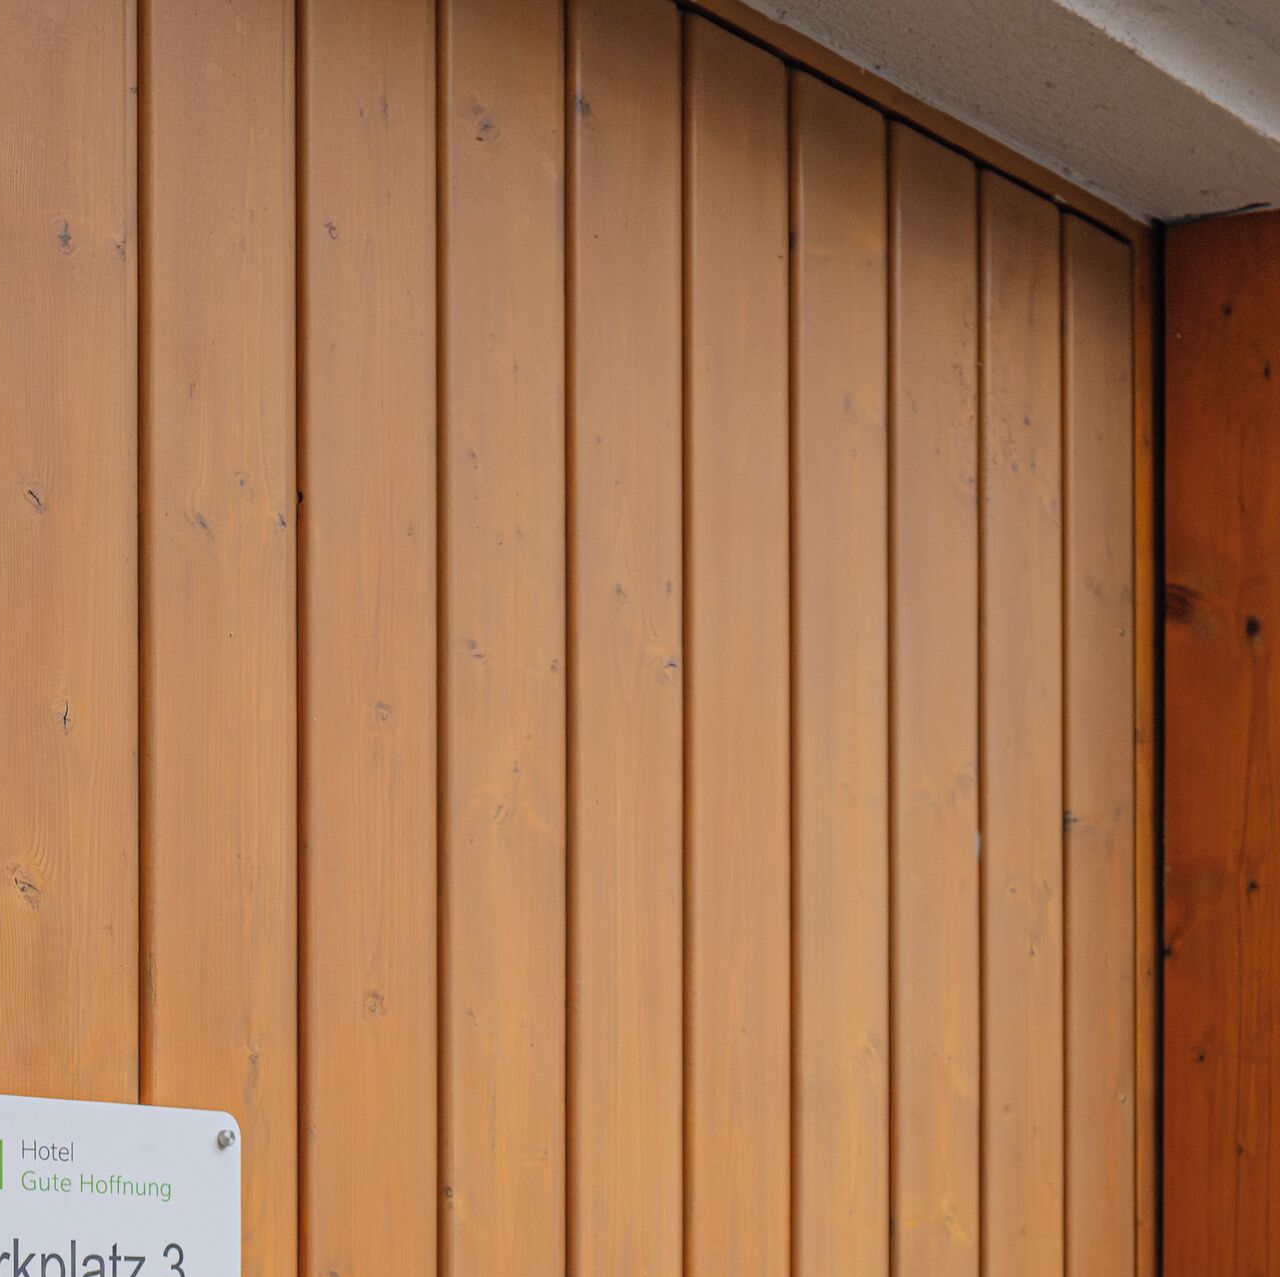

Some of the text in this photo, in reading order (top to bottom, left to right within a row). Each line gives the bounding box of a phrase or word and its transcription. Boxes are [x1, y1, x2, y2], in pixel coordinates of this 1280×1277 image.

[20, 1139, 74, 1162] Hotel
[20, 1171, 173, 1202] Gute Hoffnung
